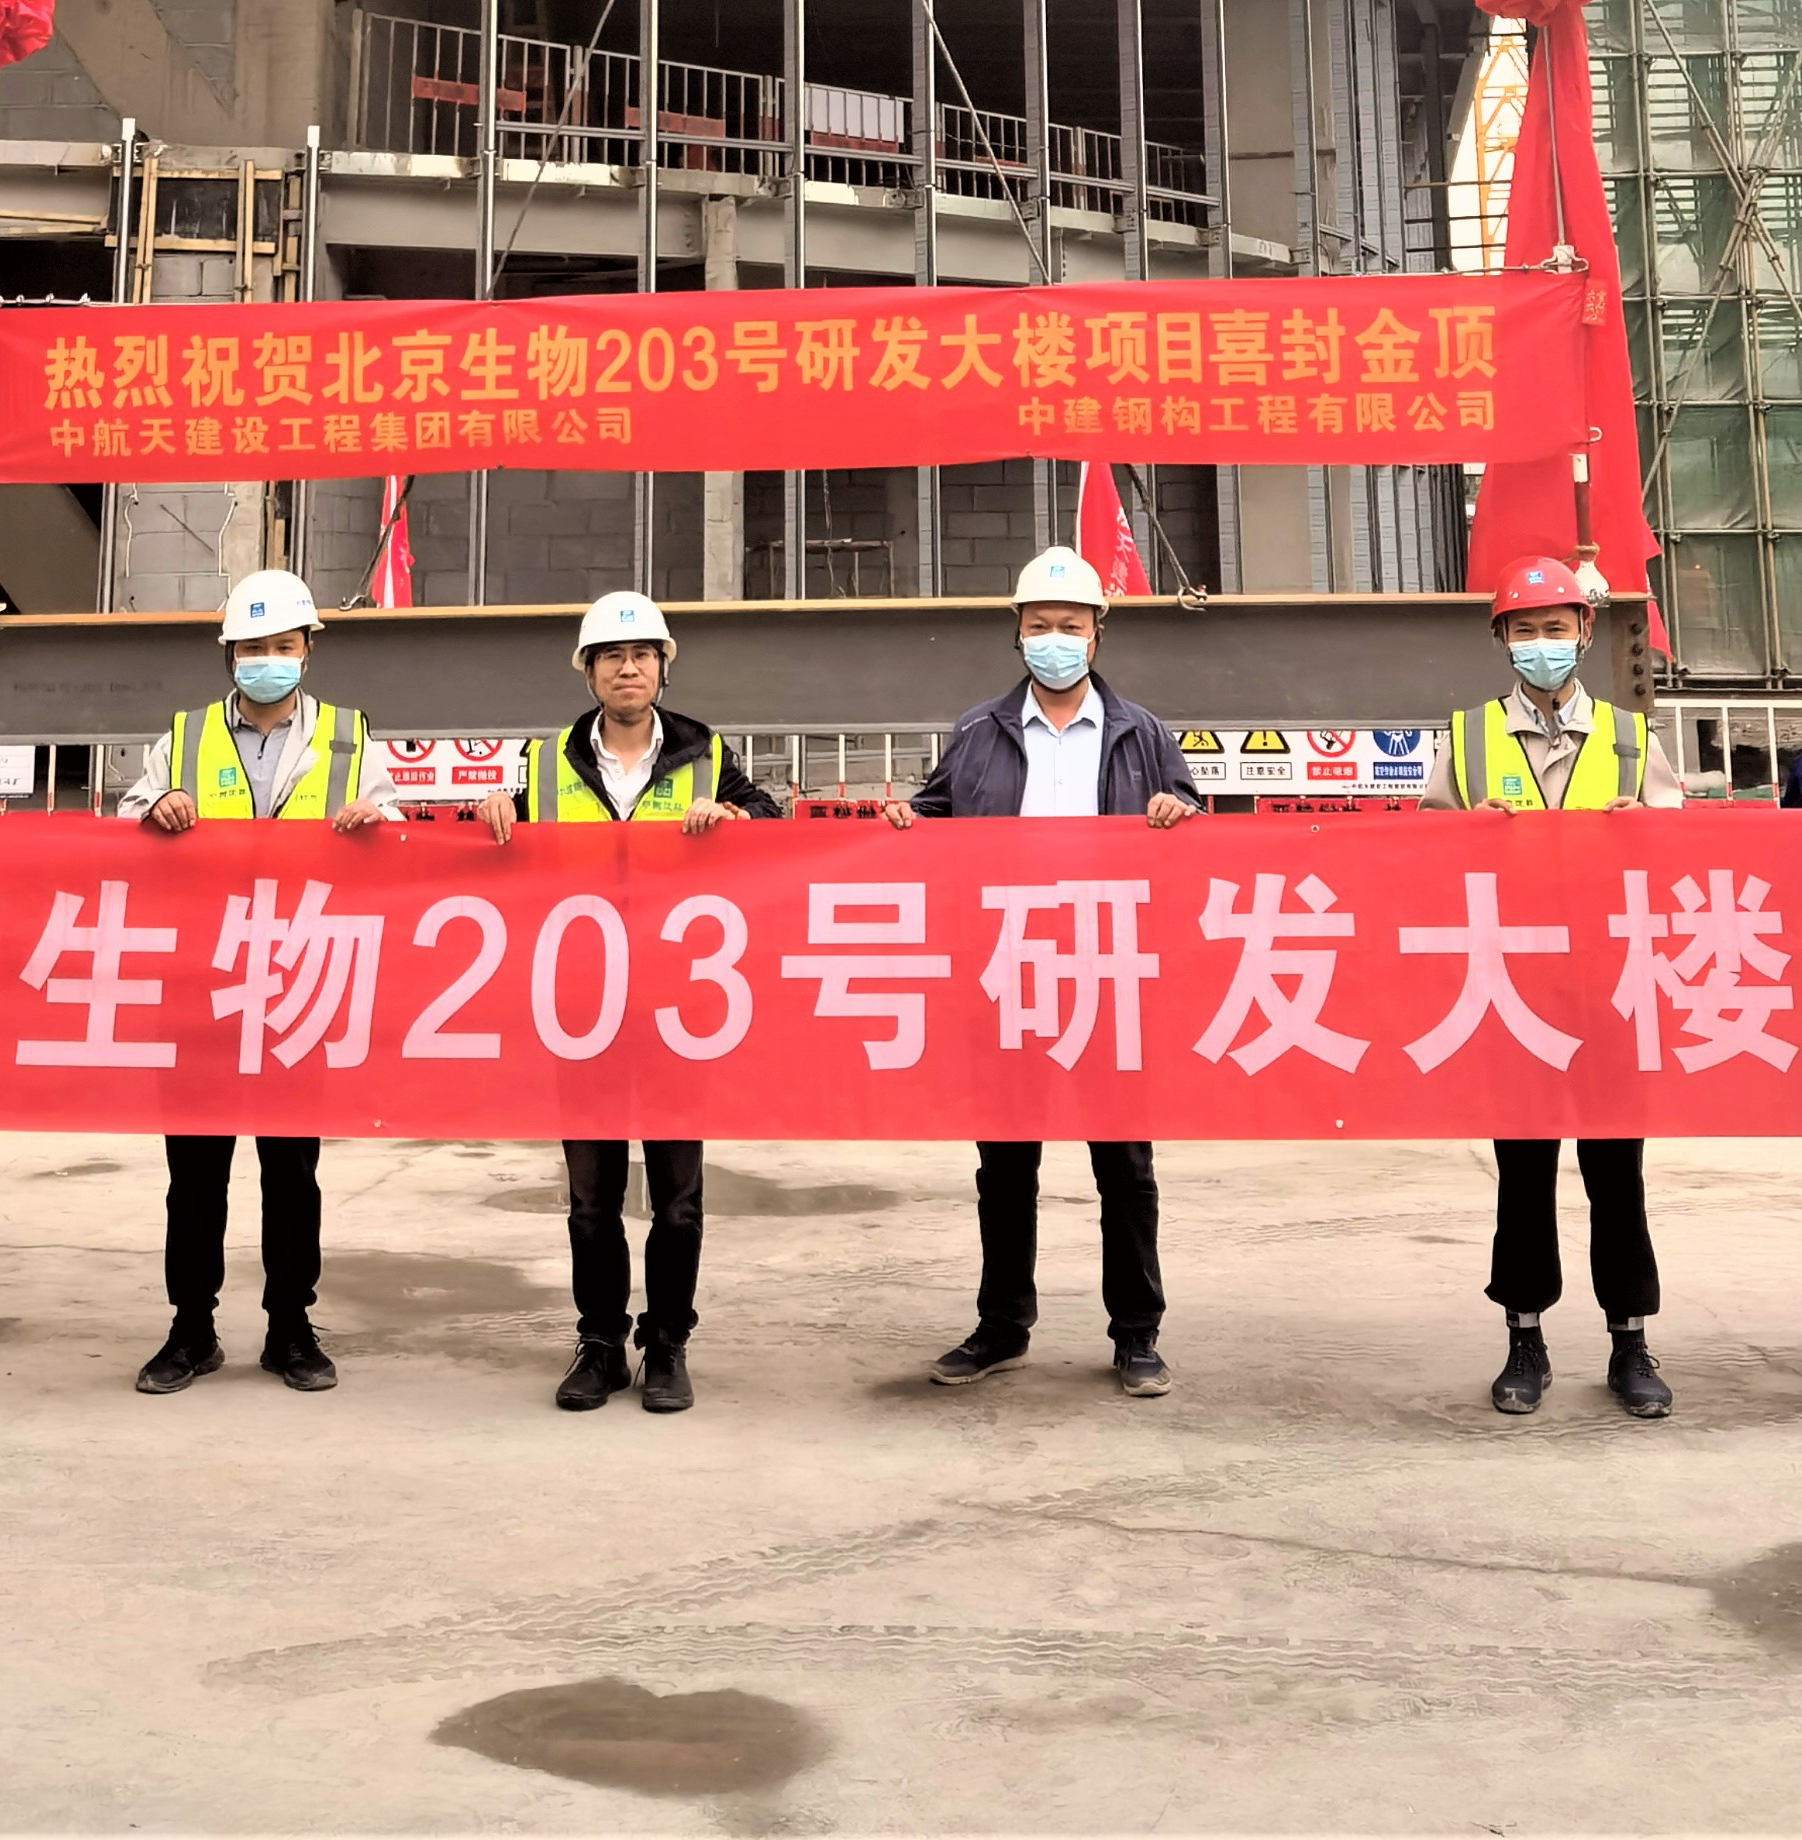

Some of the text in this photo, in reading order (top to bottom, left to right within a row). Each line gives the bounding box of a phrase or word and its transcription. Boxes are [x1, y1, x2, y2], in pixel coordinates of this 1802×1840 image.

[44, 305, 1497, 409] 热烈祝贺北京生物203号研发大楼项目喜封金顶
[49, 406, 633, 458] 中航天建设工程集团有限公司
[1017, 390, 1496, 436] 中建钢构工程有限公司
